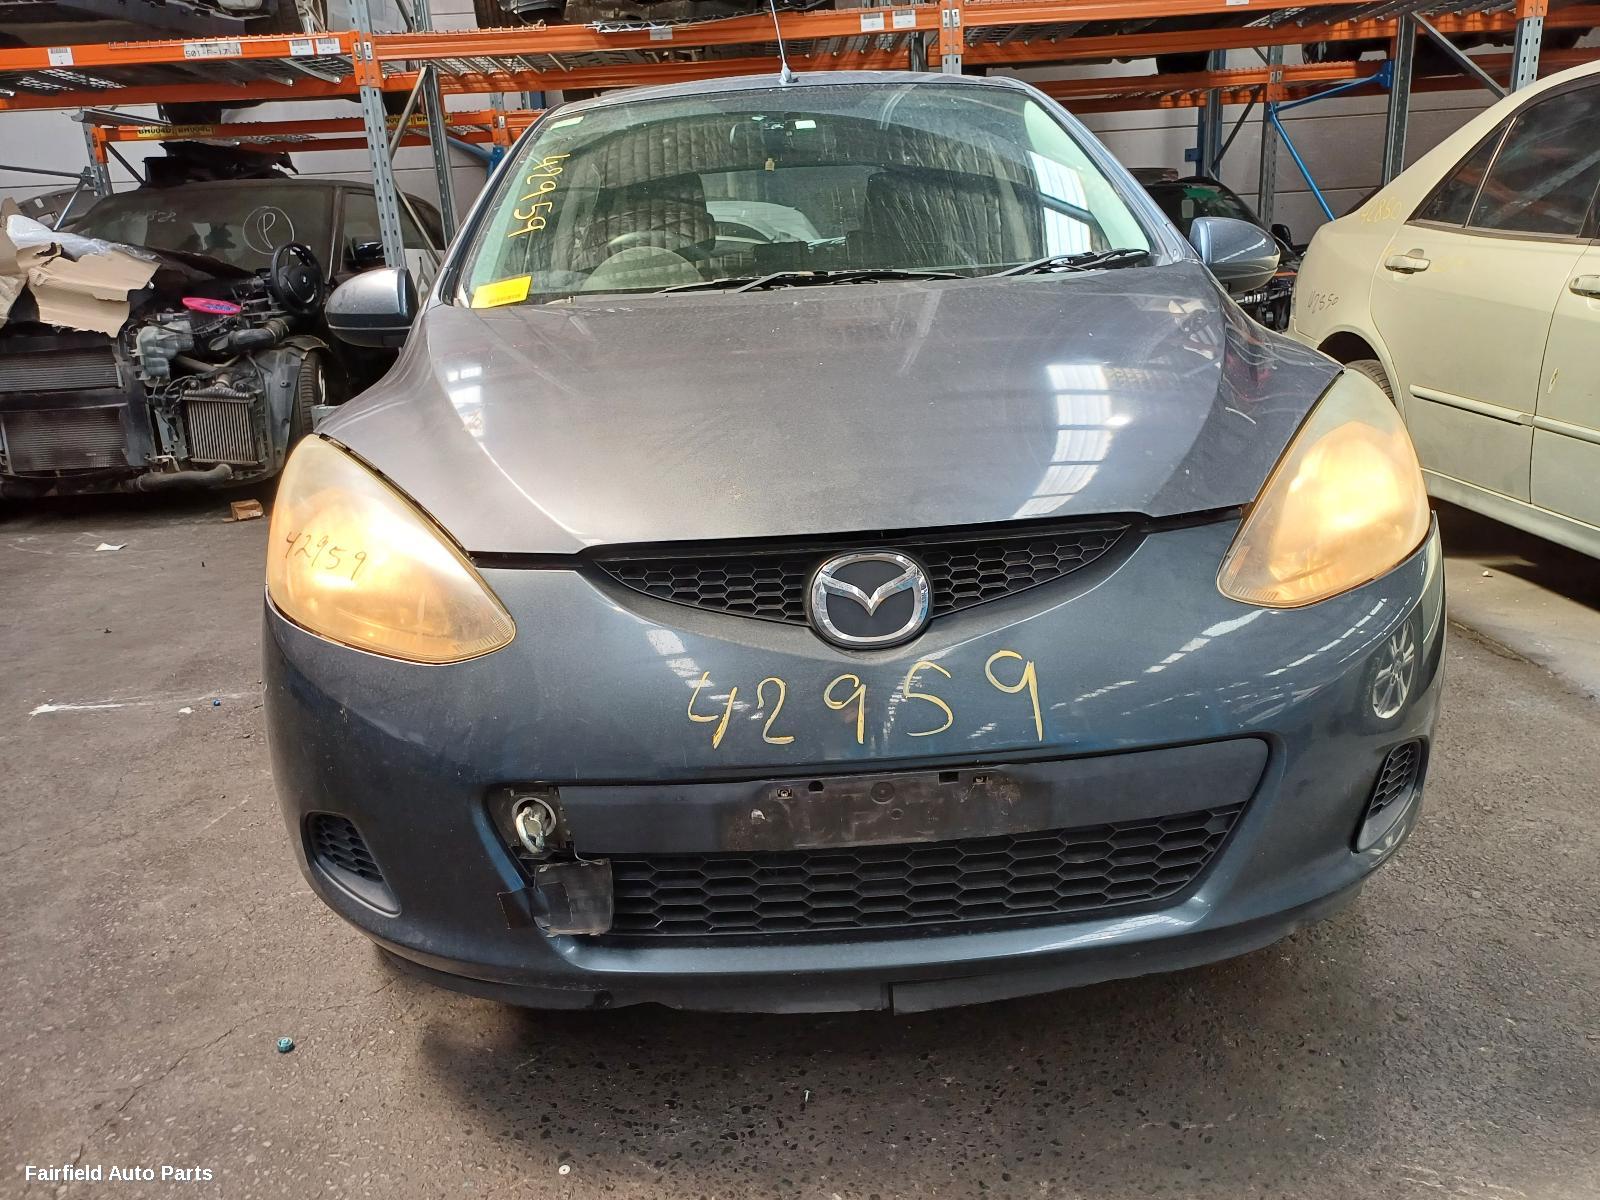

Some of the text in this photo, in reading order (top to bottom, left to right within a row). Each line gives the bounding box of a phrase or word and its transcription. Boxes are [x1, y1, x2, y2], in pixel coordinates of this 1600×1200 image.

[507, 153, 570, 238] 42959
[285, 531, 368, 581] 42959
[687, 649, 1044, 750] 42959
